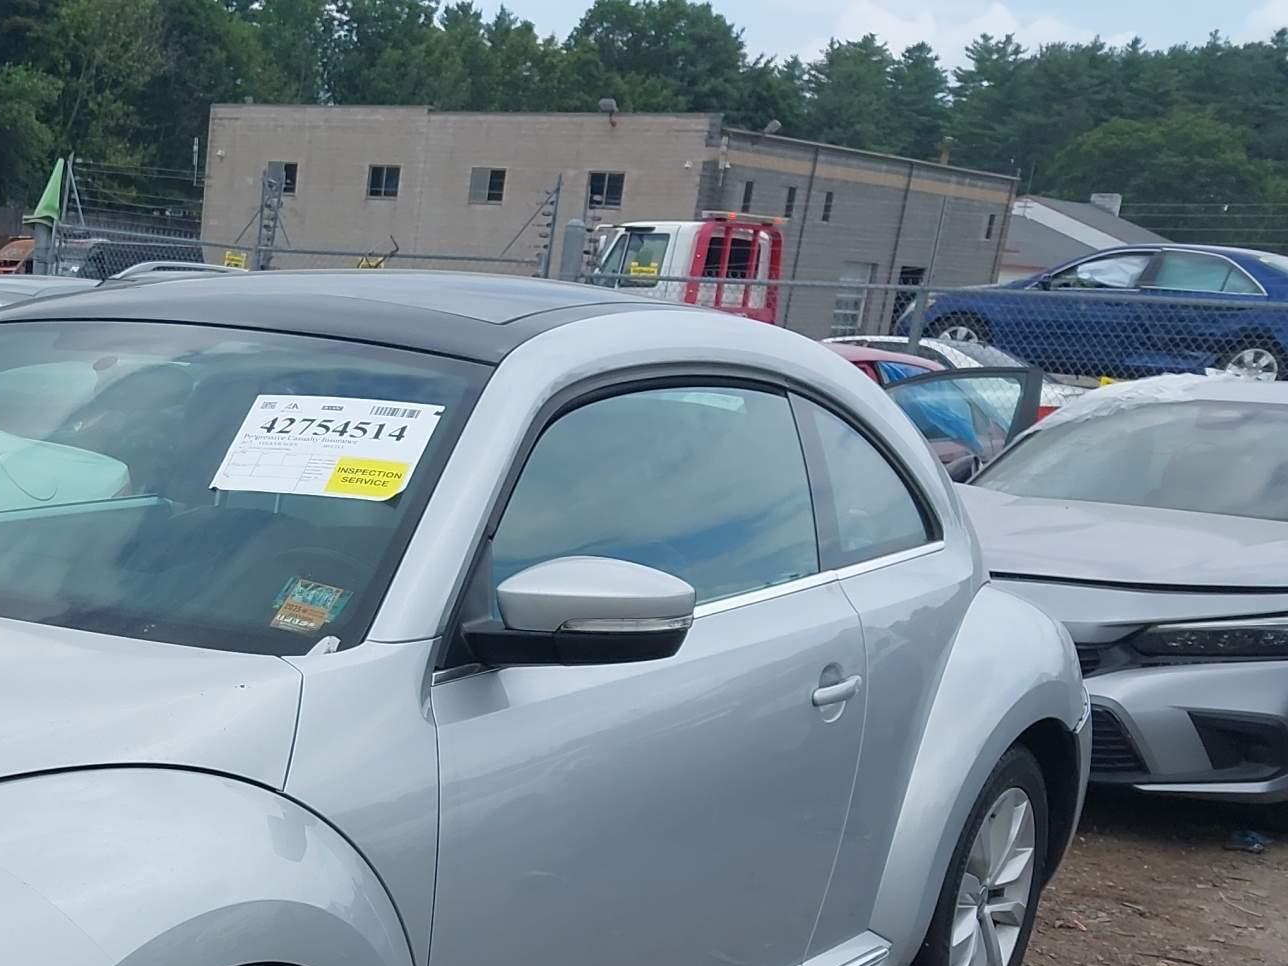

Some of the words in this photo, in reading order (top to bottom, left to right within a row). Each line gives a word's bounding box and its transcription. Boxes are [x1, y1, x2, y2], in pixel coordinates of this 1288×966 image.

[259, 416, 409, 442] 42754514
[337, 466, 403, 479] INSPECTION
[340, 476, 390, 488] SERVICE
